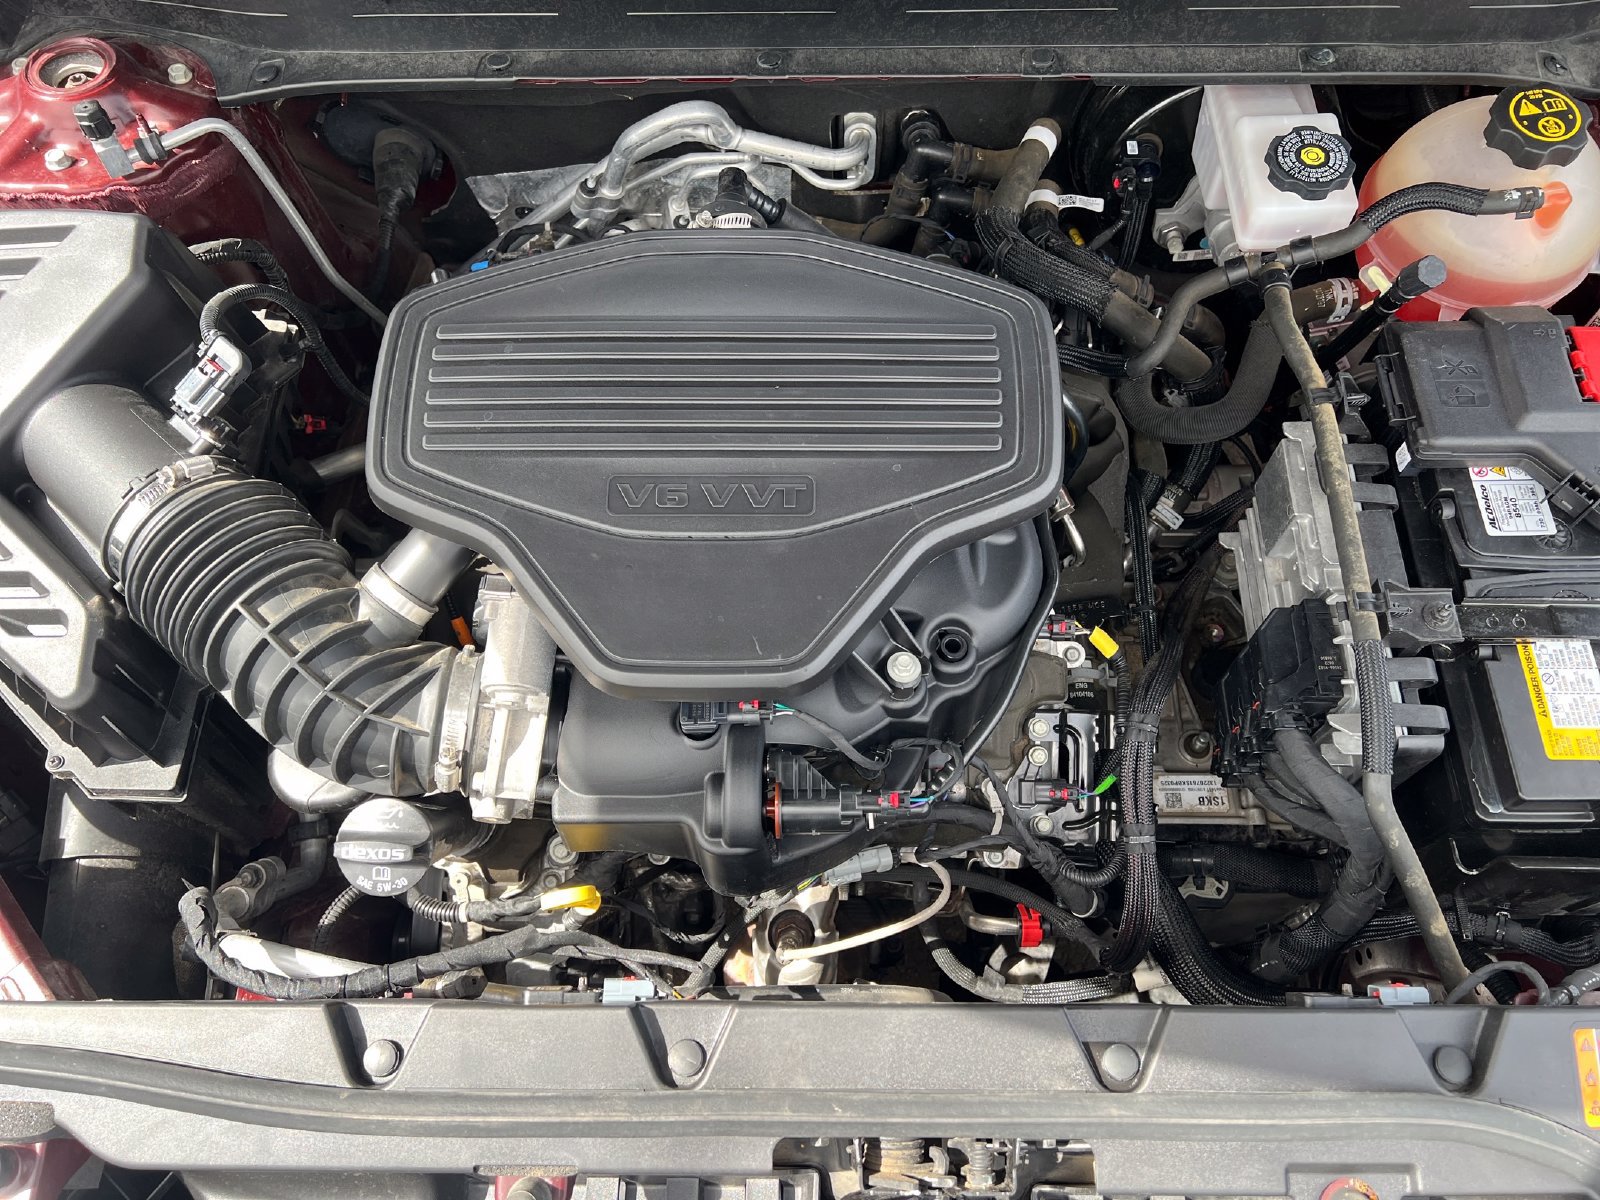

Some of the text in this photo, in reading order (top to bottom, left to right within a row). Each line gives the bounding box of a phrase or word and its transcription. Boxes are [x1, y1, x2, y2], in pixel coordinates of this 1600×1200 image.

[616, 482, 807, 509] V6 VVT
[1480, 484, 1499, 530] ACDelco
[1198, 795, 1226, 807] 1SKB
[341, 843, 406, 860] dexos
[356, 876, 408, 892] SAE 5W-30
